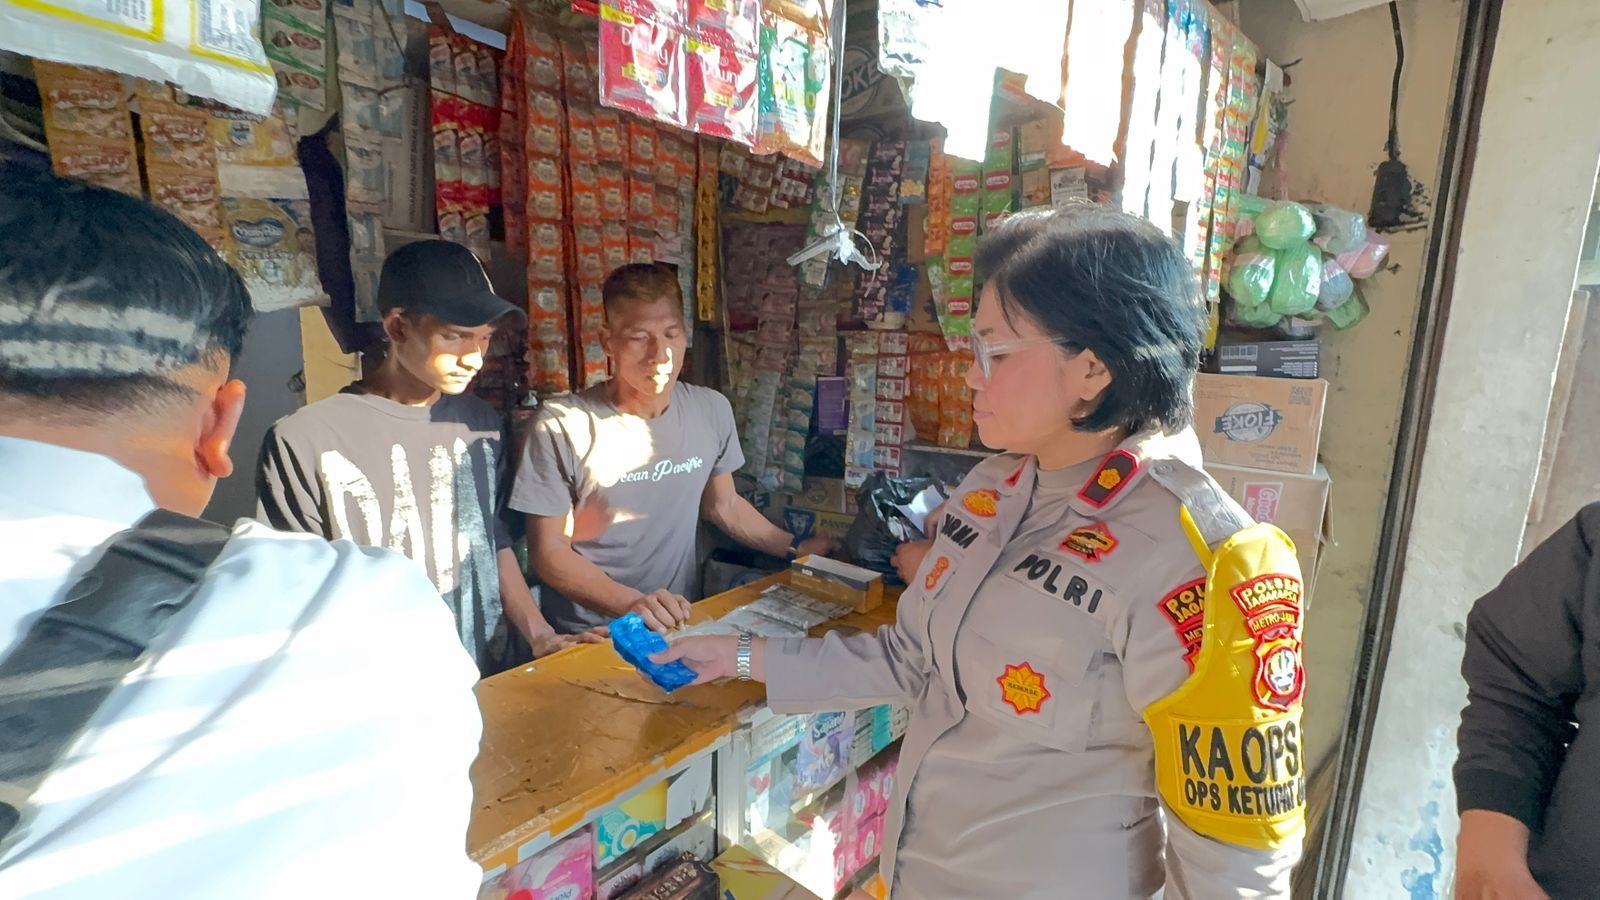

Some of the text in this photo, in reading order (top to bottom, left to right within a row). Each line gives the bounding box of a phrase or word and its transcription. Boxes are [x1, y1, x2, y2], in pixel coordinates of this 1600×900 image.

[619, 456, 703, 482] cean Pacific
[1013, 554, 1103, 614] POLRI
[1165, 584, 1206, 614] POL
[1179, 720, 1299, 784] KA OPS
[1184, 778, 1221, 811] OPS
[1227, 780, 1295, 816] KETUPAT
